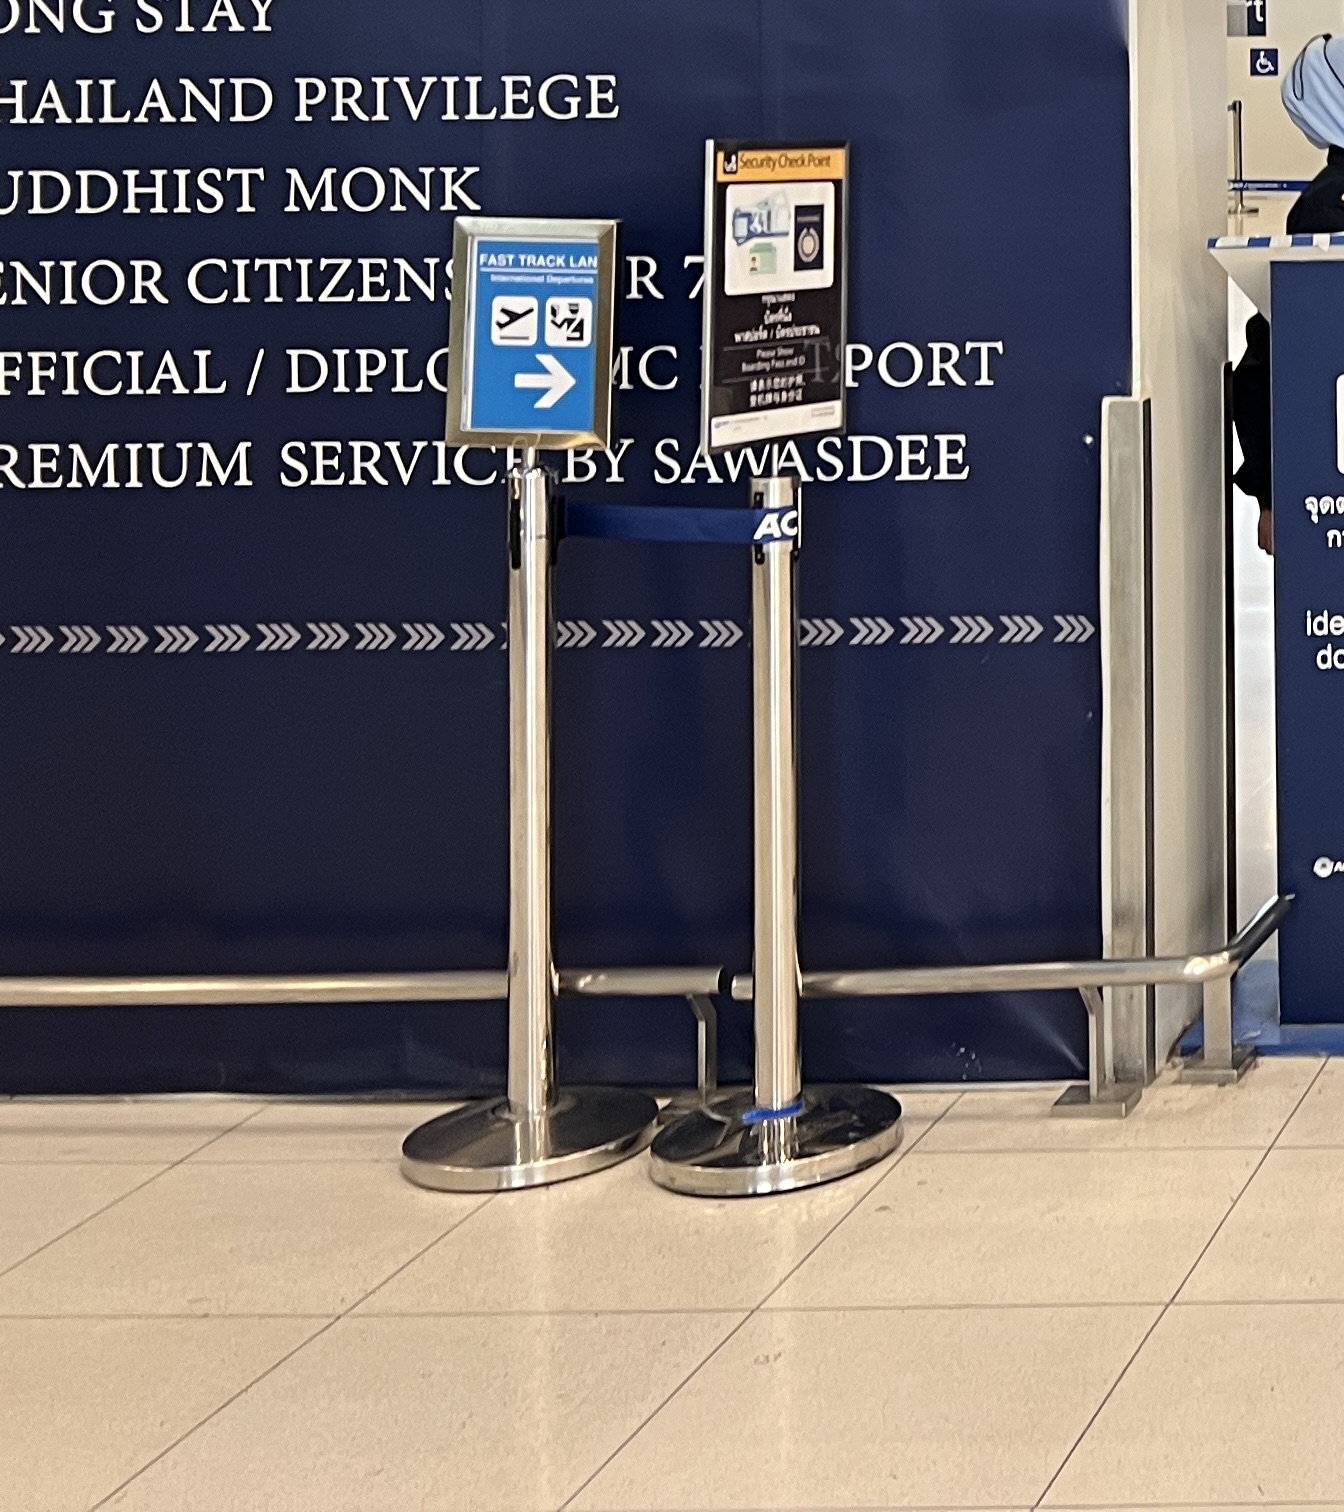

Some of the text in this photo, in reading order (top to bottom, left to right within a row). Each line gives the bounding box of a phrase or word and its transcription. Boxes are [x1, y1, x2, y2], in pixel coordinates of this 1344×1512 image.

[294, 74, 620, 122] PRIVILEGE
[739, 153, 831, 171] Security Check Point
[283, 166, 482, 214] MONK
[479, 254, 515, 267] FAST
[517, 254, 566, 268] TRACK
[246, 348, 265, 396] /
[562, 438, 635, 483] BY
[653, 436, 970, 484] SAWASDEE
